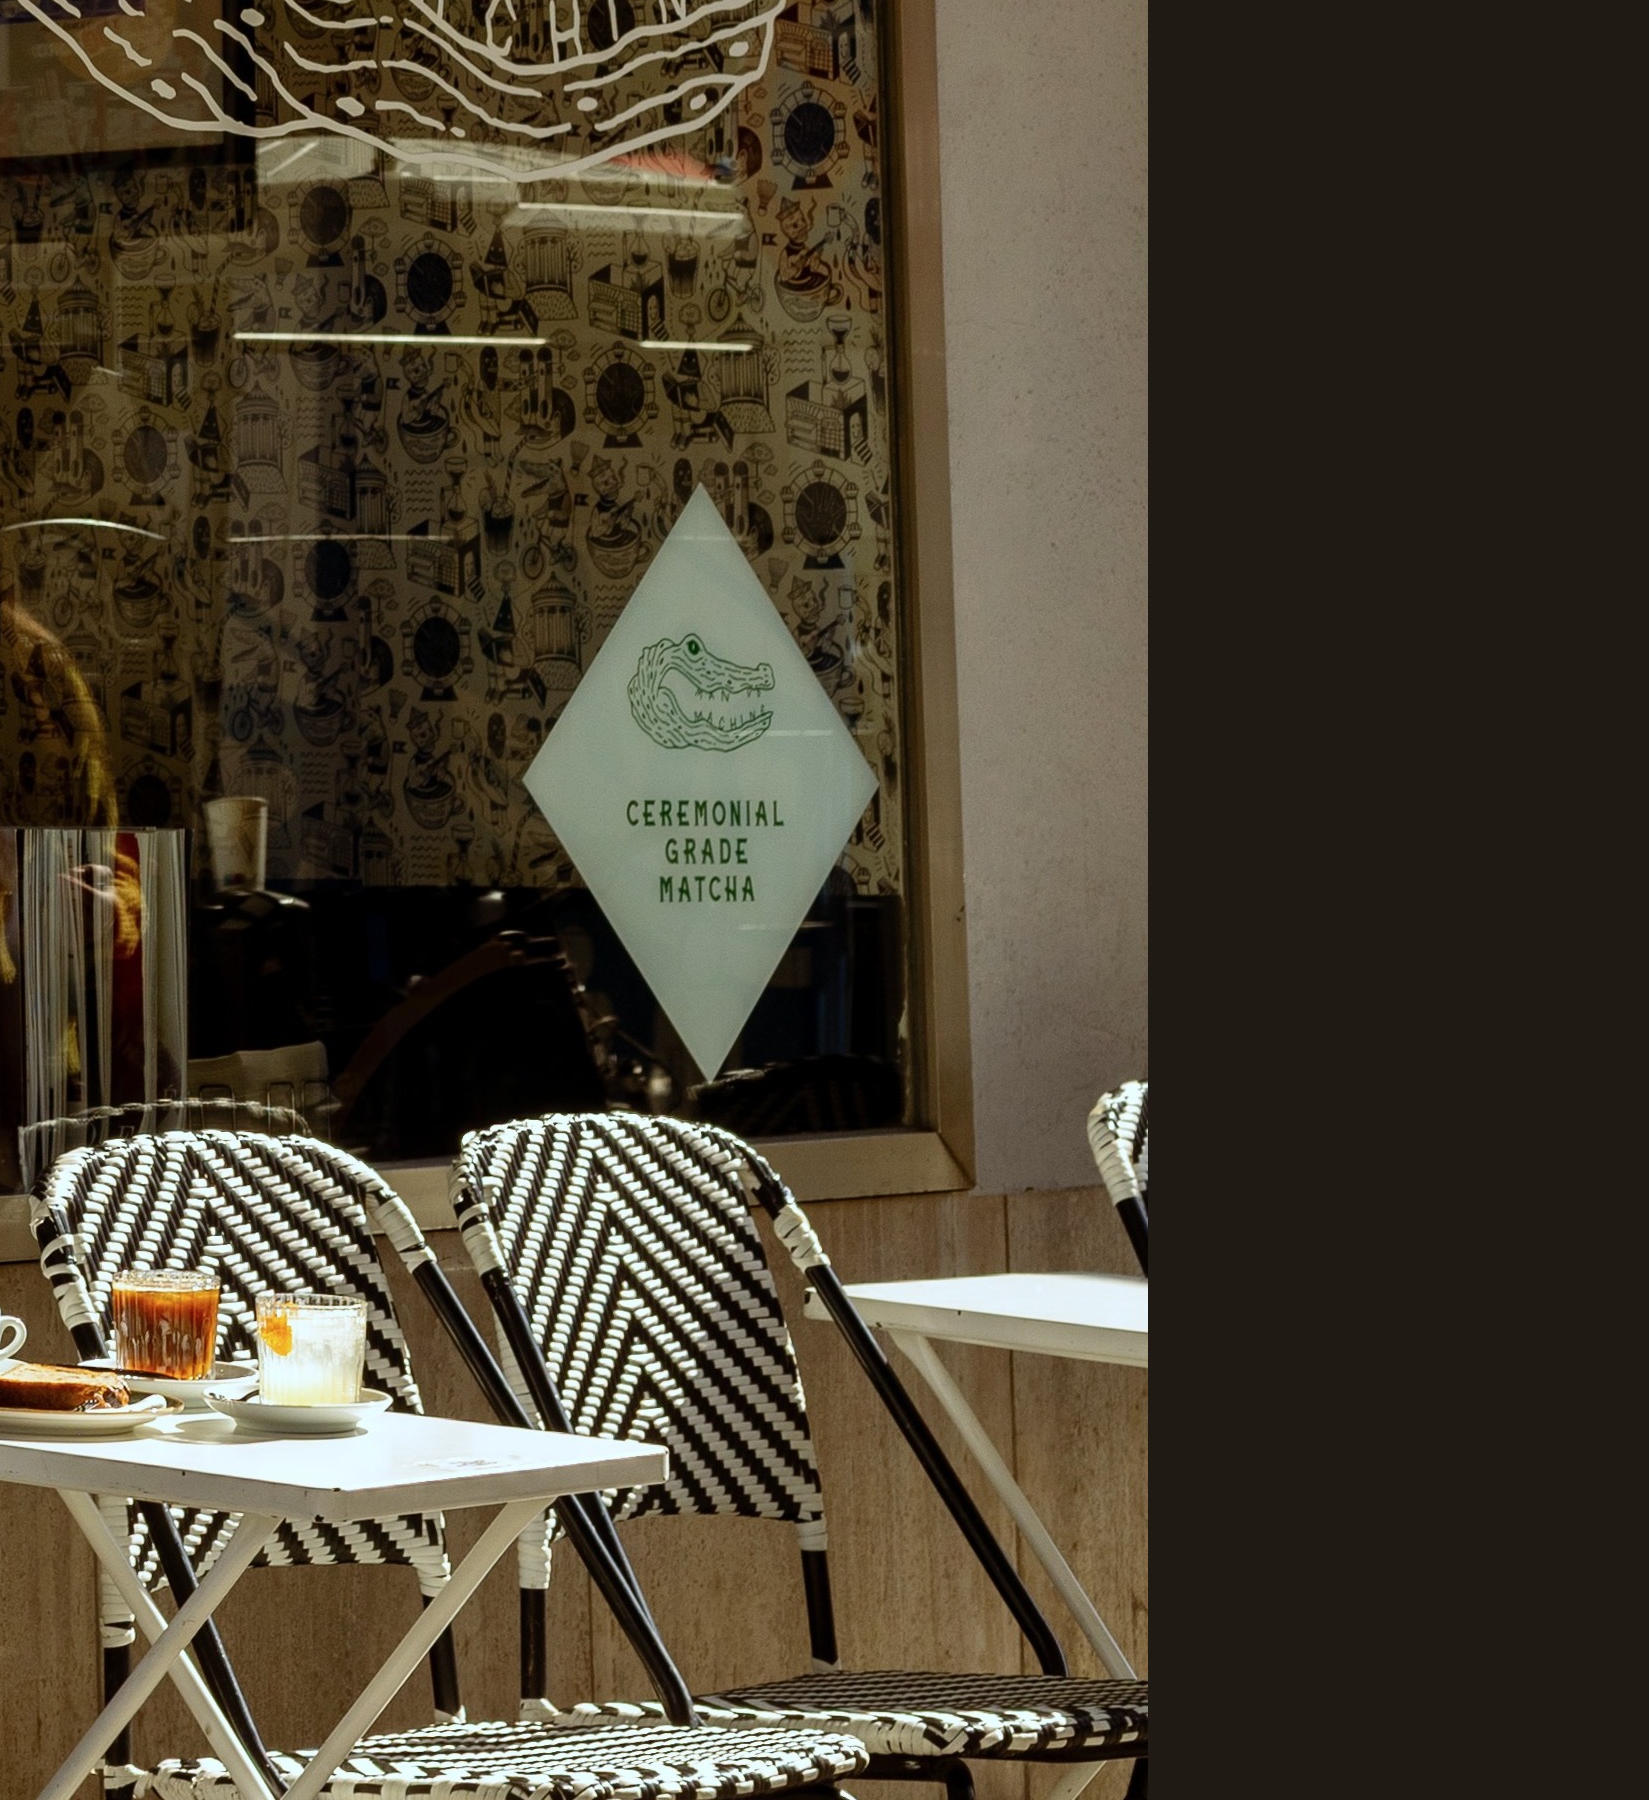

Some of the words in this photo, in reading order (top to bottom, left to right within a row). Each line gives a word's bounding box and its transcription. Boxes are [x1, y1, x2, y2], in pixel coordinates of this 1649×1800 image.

[626, 800, 785, 828] CEREMONIAL
[665, 838, 749, 866] GRADE
[659, 875, 756, 903] MATCHA
